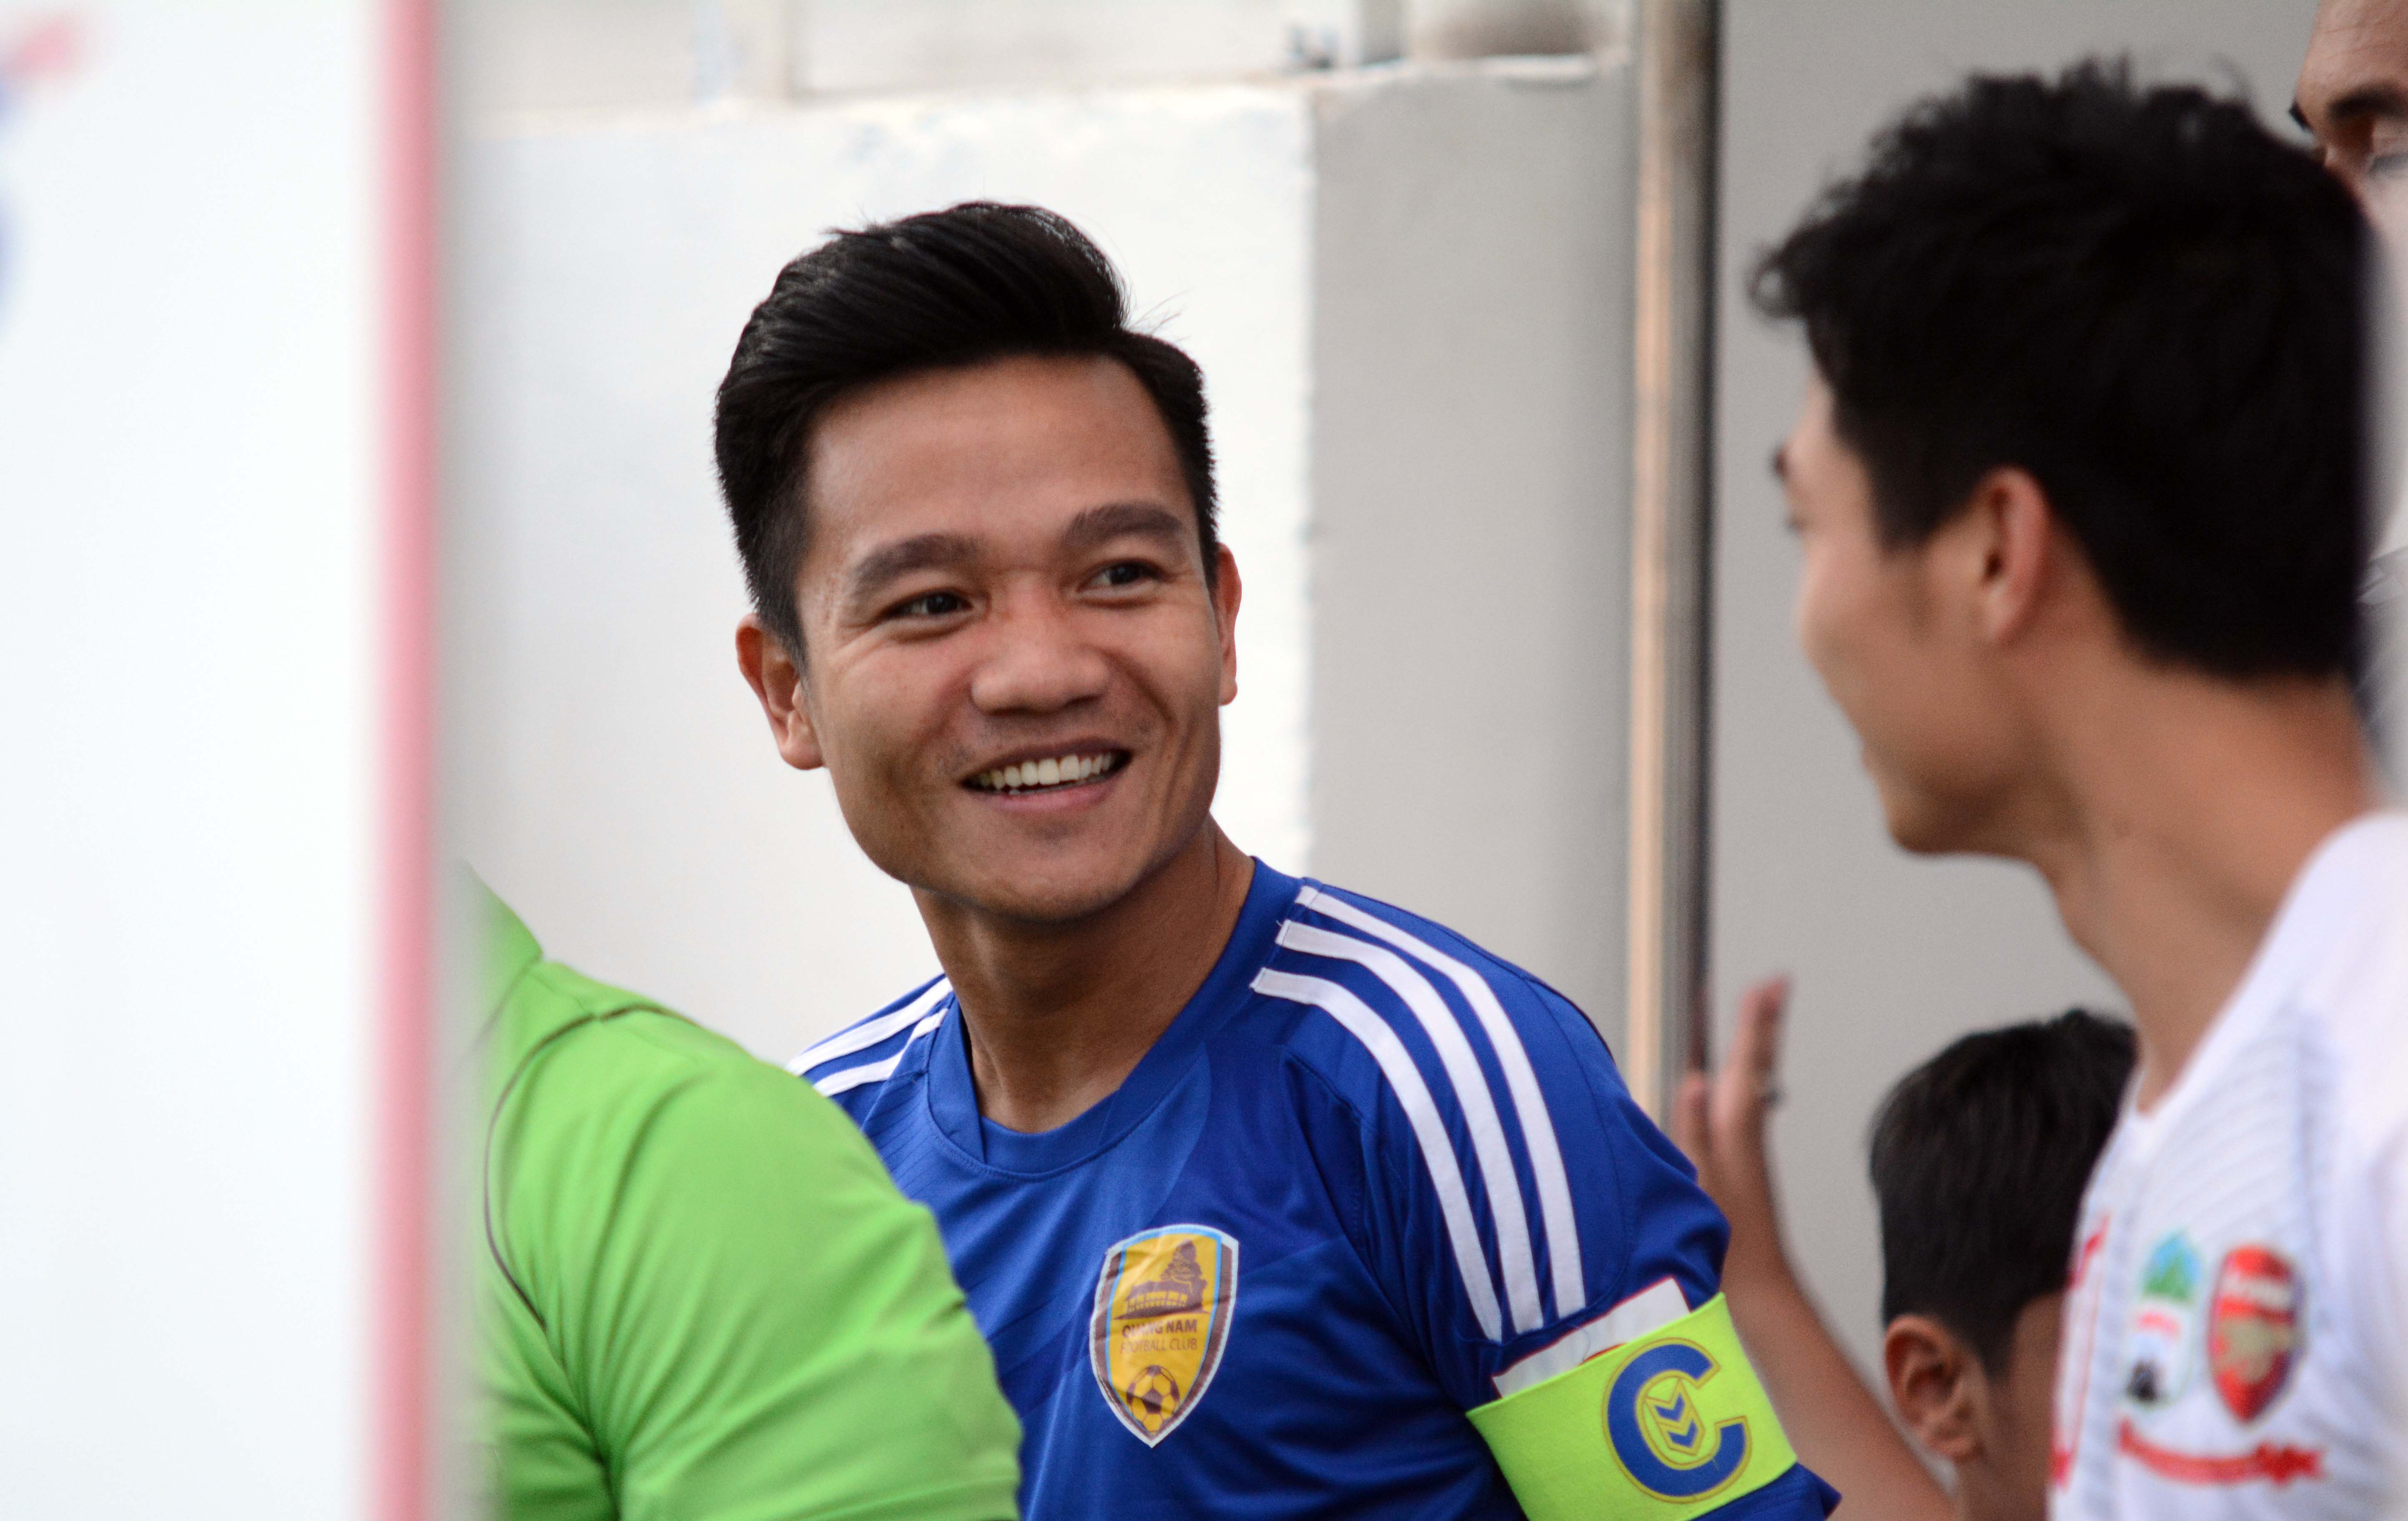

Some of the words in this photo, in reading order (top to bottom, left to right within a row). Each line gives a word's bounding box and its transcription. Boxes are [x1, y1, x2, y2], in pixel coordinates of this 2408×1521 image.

[1166, 1318, 1197, 1333] NAM
[1120, 1339, 1166, 1353] FOOTBALL
[1169, 1337, 1197, 1351] CLUB
[1602, 1338, 1751, 1503] C
